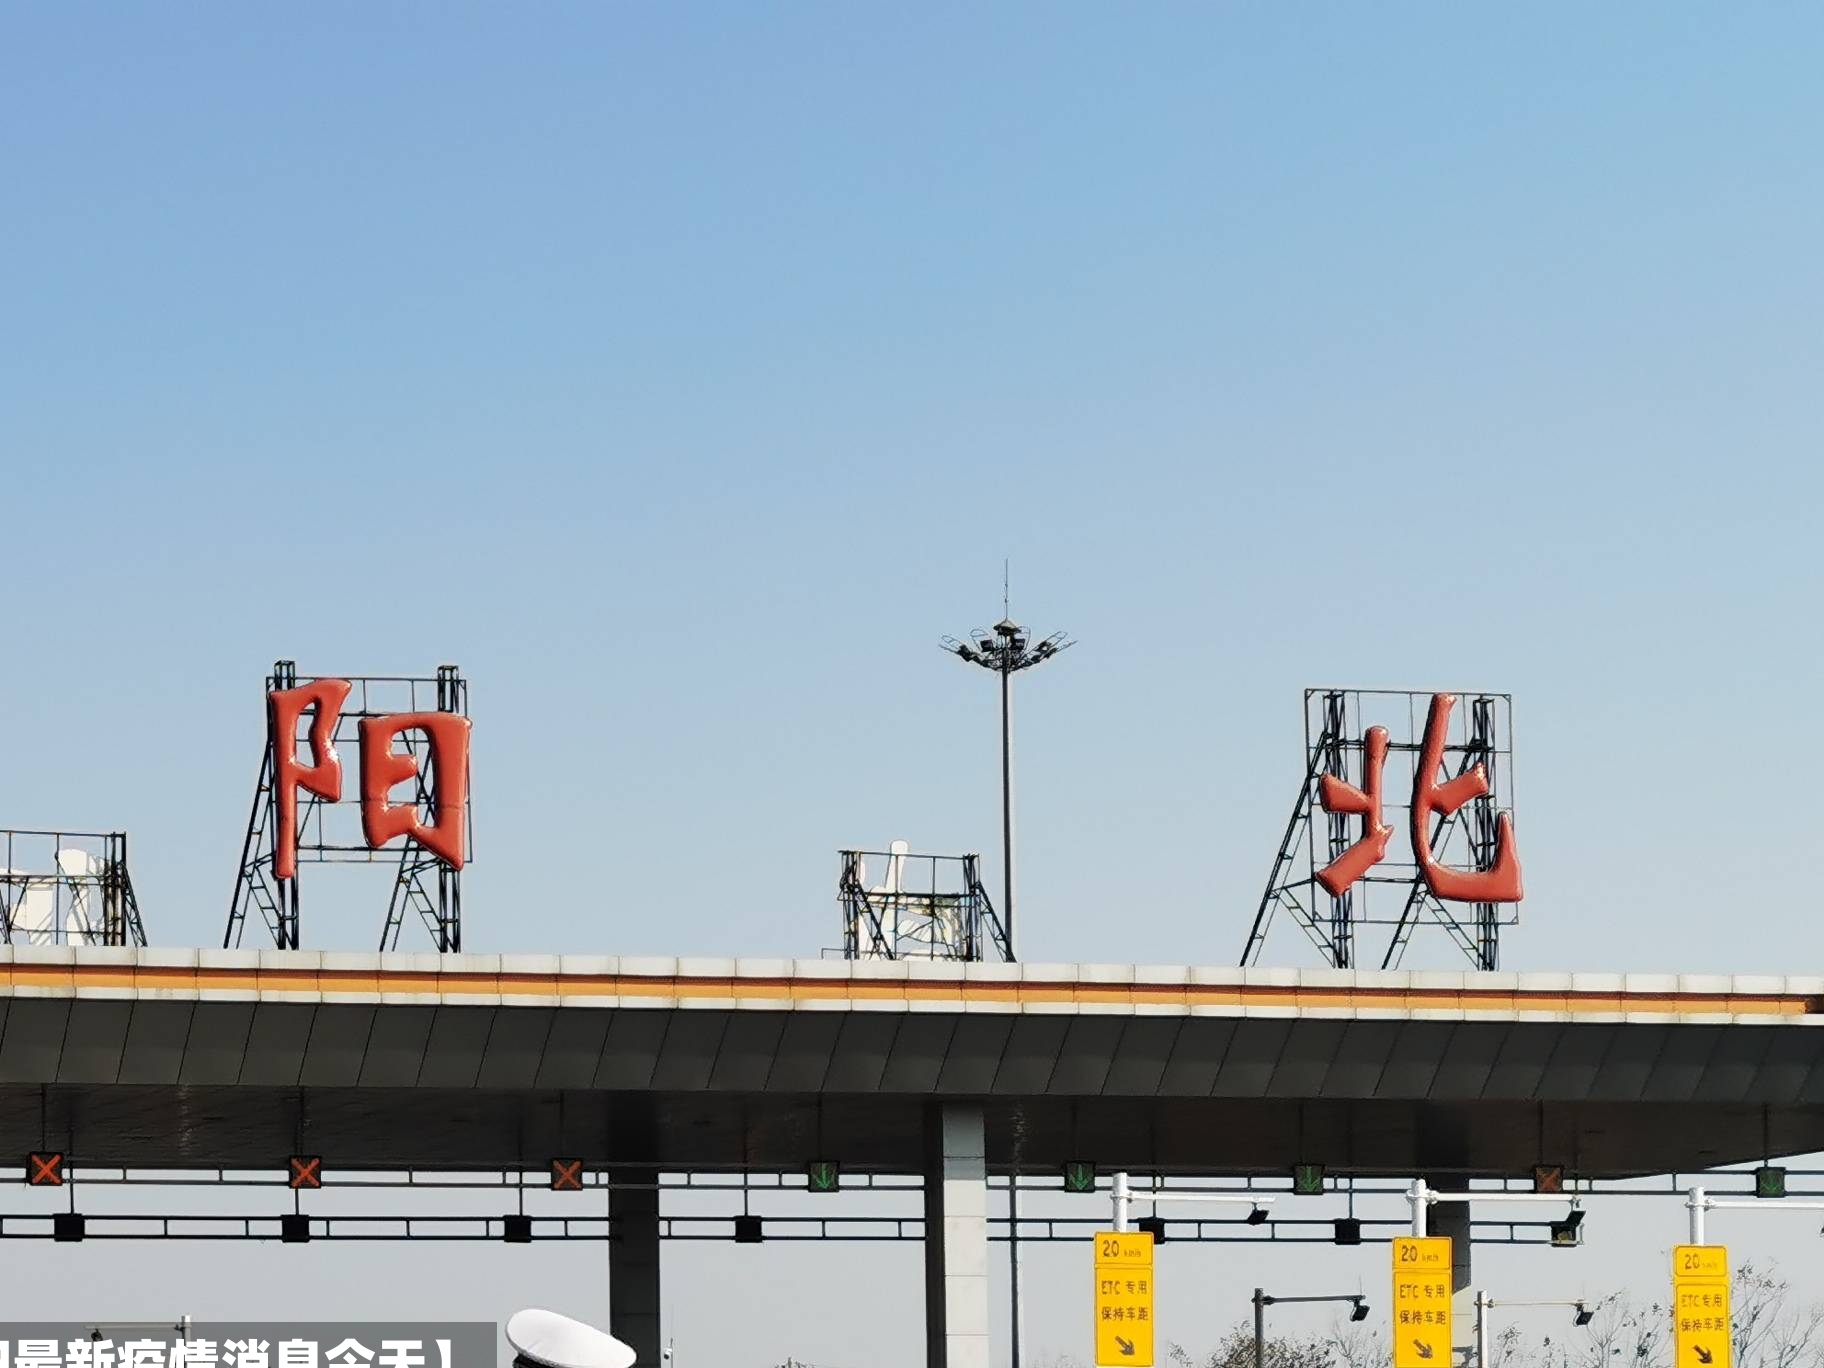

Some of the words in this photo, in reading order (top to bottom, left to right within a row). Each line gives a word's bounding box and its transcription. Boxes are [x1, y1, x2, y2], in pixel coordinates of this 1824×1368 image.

[1102, 1239, 1119, 1257] 20
[1401, 1245, 1418, 1262] 20
[1684, 1253, 1700, 1270] 20
[1126, 1280, 1147, 1294] 专用
[1399, 1284, 1419, 1298] ETC
[1424, 1284, 1445, 1298] 专用
[1101, 1306, 1149, 1321] 保持车距
[1399, 1310, 1446, 1325] 保持车距
